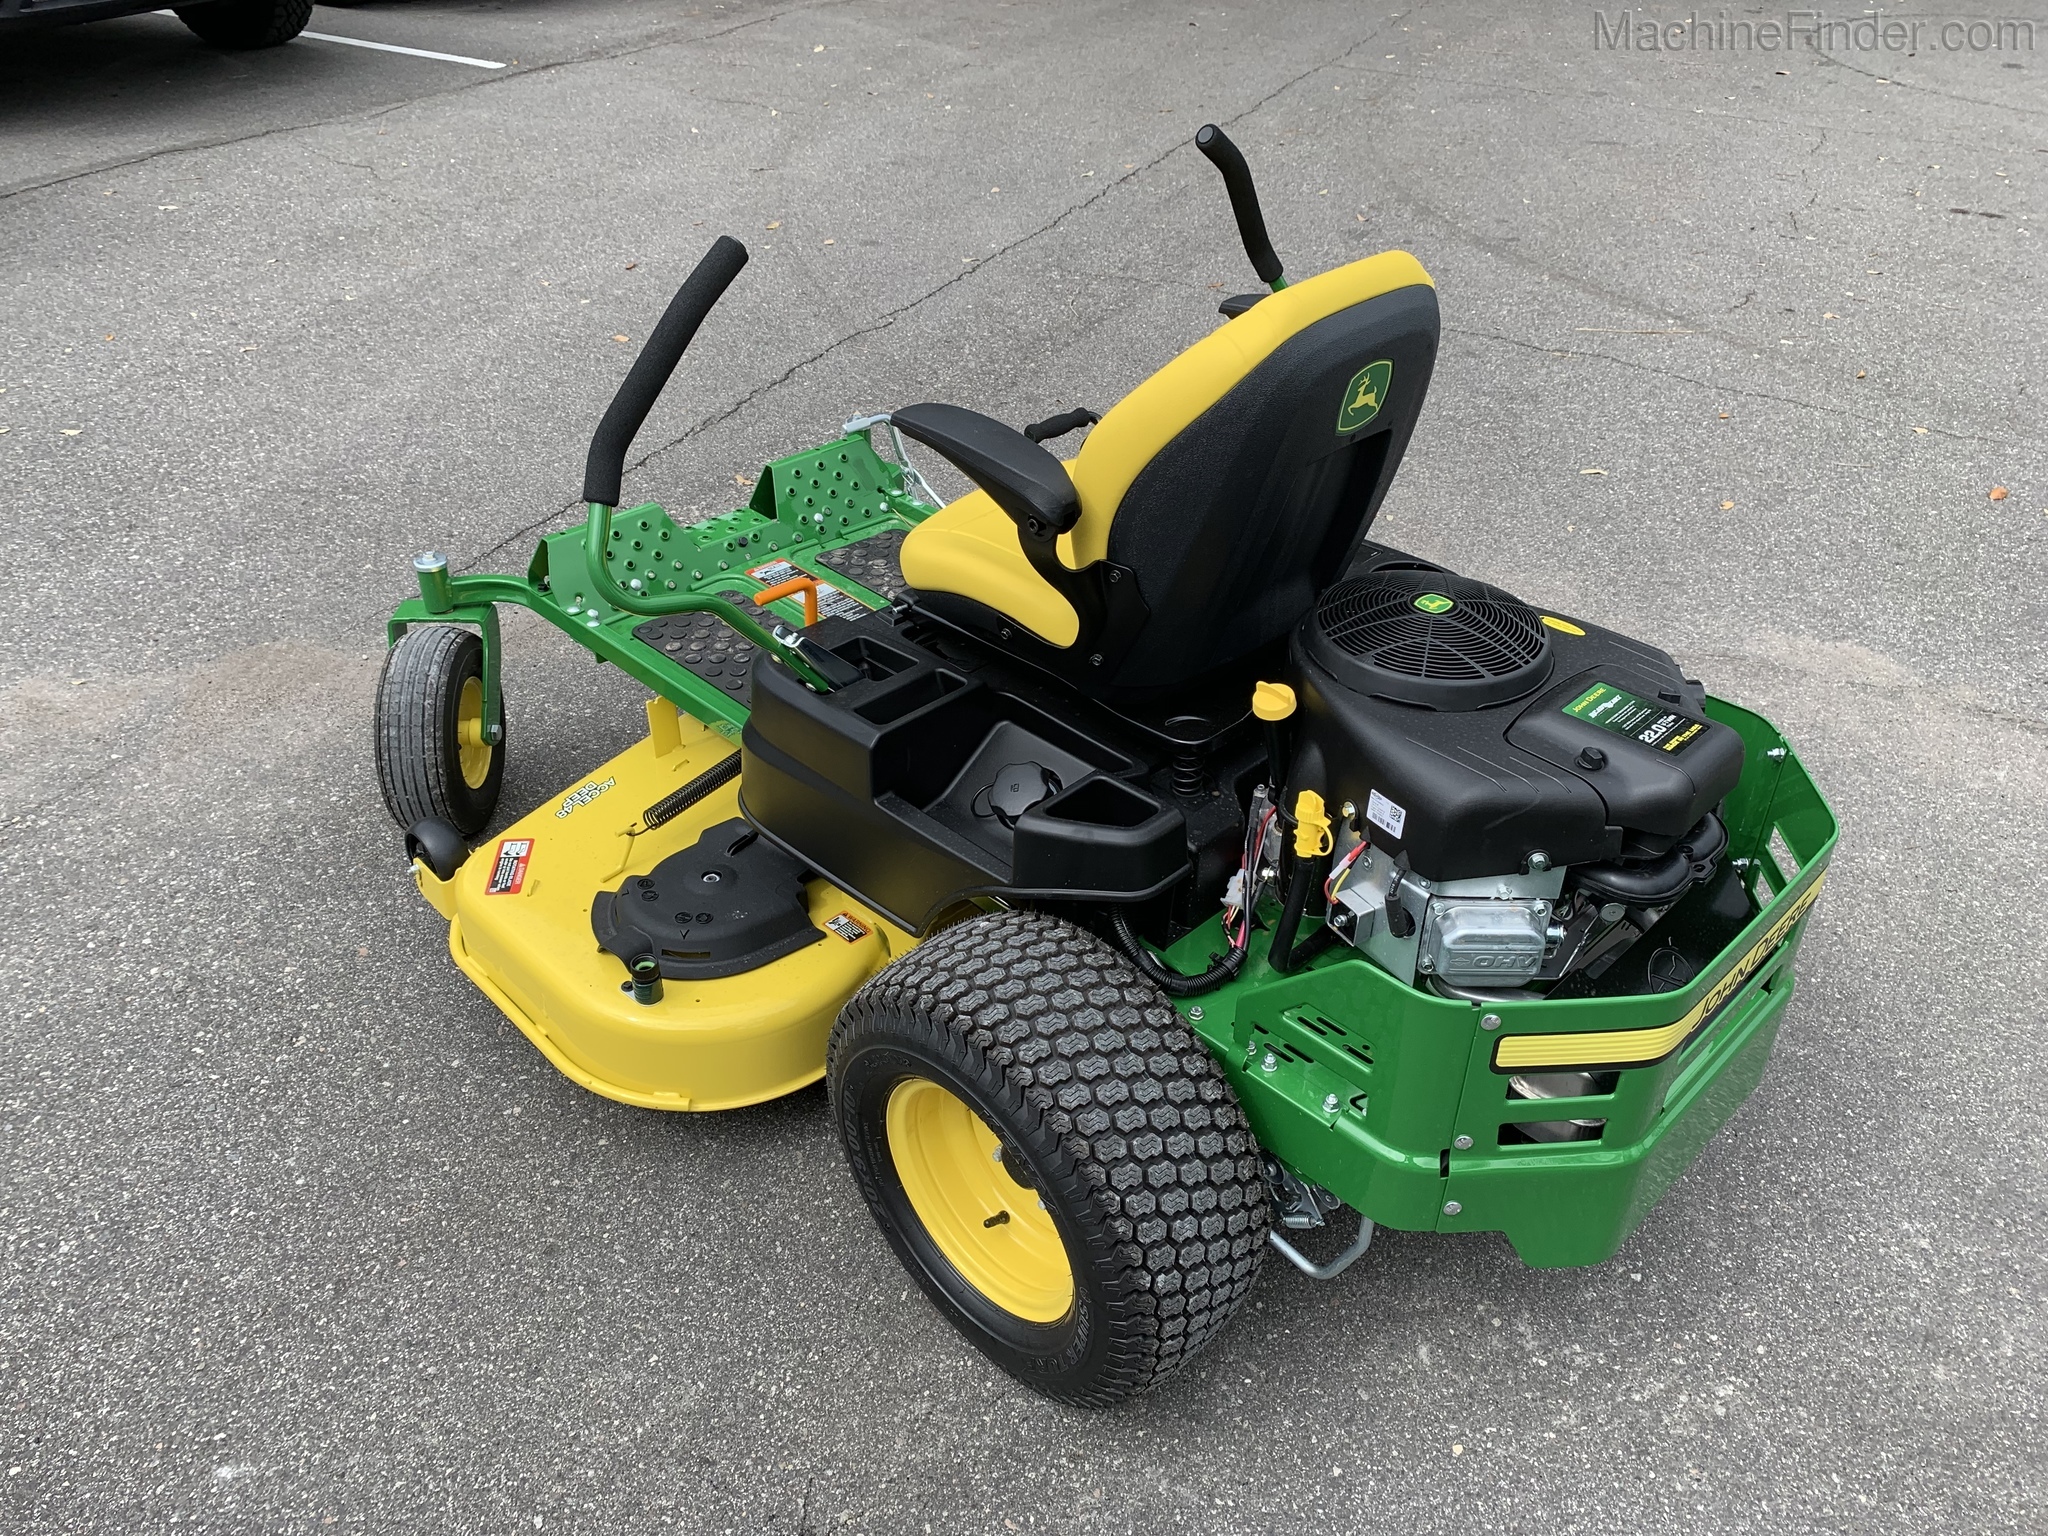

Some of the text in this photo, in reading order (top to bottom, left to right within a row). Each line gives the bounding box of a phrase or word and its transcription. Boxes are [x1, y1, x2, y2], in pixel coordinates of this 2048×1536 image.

[1572, 699, 1590, 713] JOHN
[1585, 687, 1607, 702] DEERE
[562, 781, 598, 808] DEEP
[572, 776, 616, 807] ACCEL
[1472, 955, 1538, 969] OHV
[1691, 892, 1811, 1030] JOHN DEERE
[1066, 1300, 1090, 1365] SUPER
